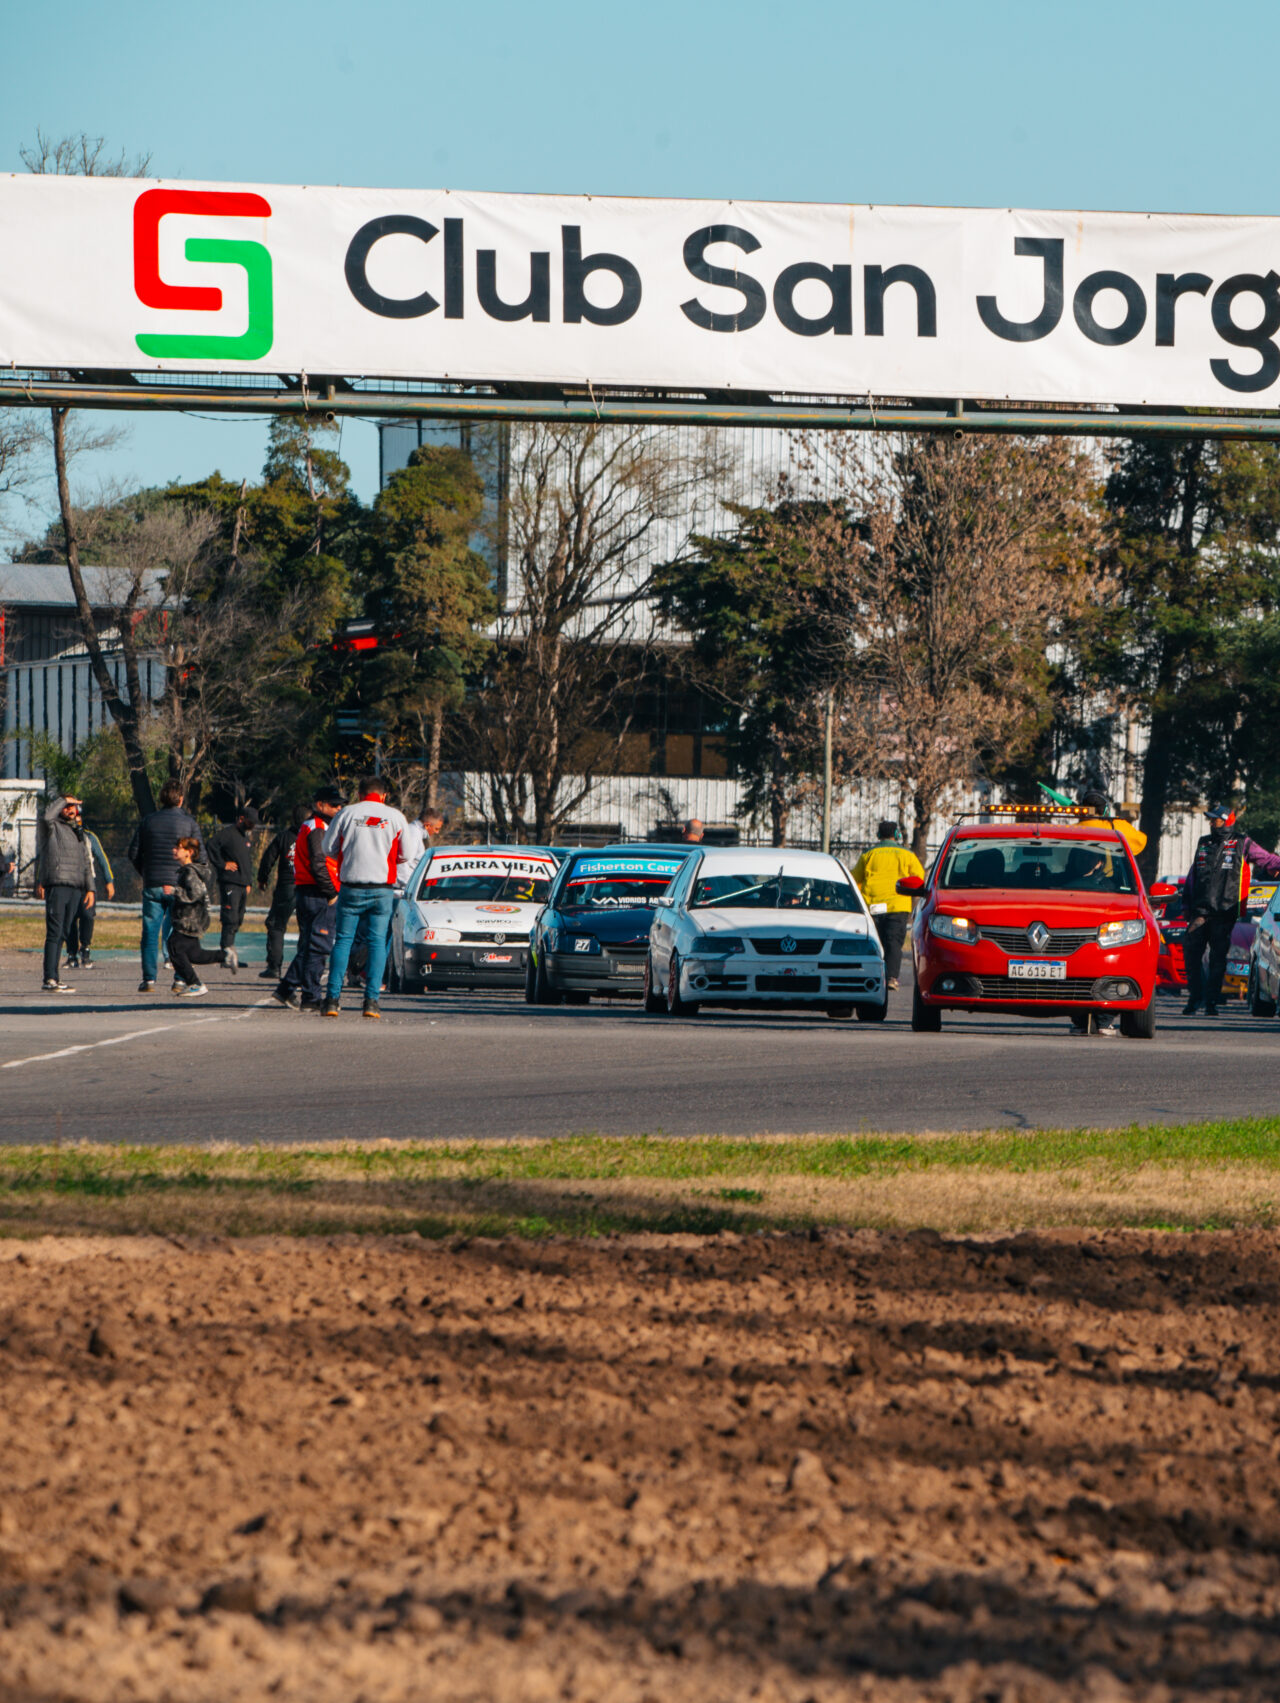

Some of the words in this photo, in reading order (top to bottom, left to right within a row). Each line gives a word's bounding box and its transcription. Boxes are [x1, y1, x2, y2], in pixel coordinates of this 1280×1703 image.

[344, 214, 642, 326] Club
[680, 224, 937, 337] San
[440, 861, 498, 873] BARRA
[501, 862, 546, 875] VIEJA
[580, 862, 643, 873] Fisherton
[647, 863, 677, 873] Cars
[424, 931, 435, 940] 23
[576, 940, 590, 950] 27
[1011, 966, 1024, 977] AC
[1050, 967, 1063, 978] ET
